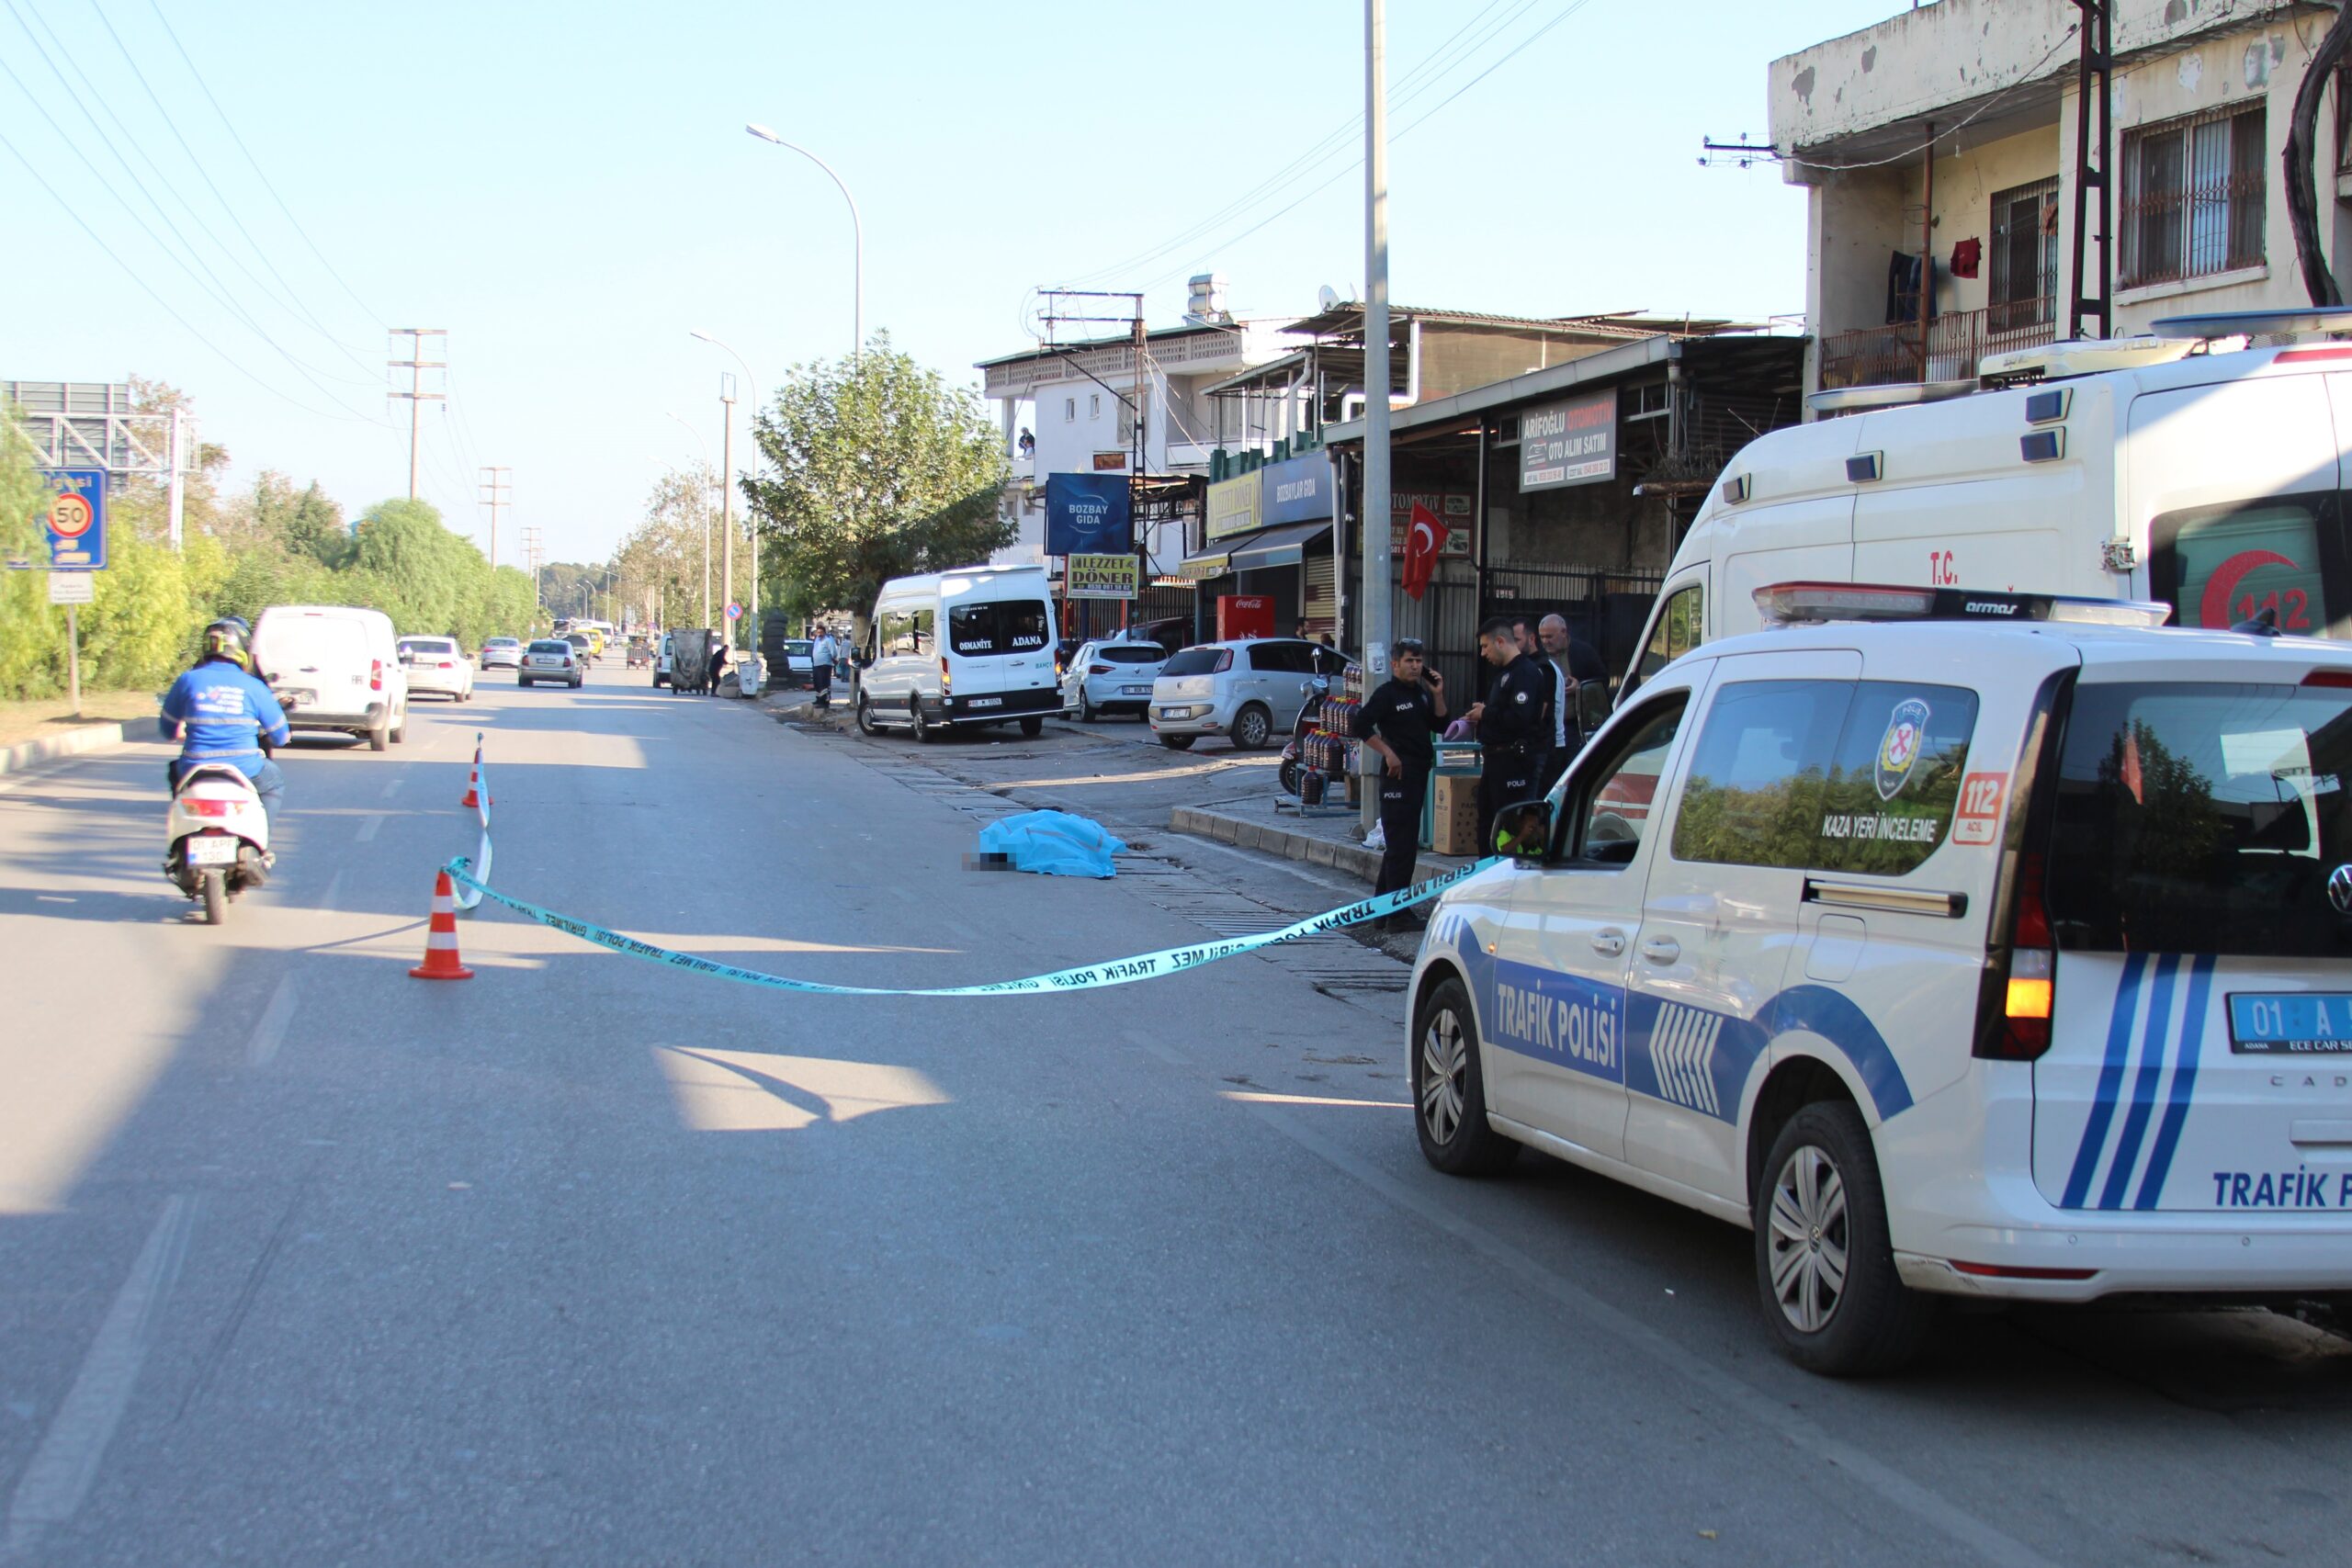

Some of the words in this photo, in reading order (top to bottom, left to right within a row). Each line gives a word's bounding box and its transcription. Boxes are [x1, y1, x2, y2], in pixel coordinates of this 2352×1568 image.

[1524, 410, 1566, 440] ARİFOĞLU
[1567, 398, 1613, 433] OTOMOTİV
[1548, 441, 1563, 461] OTO
[1564, 437, 1582, 458] ALIM
[1583, 432, 1607, 455] SATIM
[1276, 482, 1304, 503] BOZBAYLAR
[1303, 479, 1316, 499] GIDA
[57, 507, 85, 524] 50
[1069, 504, 1109, 514] BOZBAY
[1076, 514, 1101, 525] GIDA
[1083, 558, 1125, 570] LEZZET
[1930, 550, 1959, 585] T.C.
[1072, 569, 1134, 584] DÖNER
[1965, 602, 2018, 615] armas
[2236, 589, 2311, 629] 112
[959, 638, 992, 651] OSMANİYE
[1012, 636, 1043, 647] ADANA
[1396, 701, 1414, 713] POLİS
[1507, 779, 1526, 788] POLİS
[1966, 779, 1996, 814] 112
[1822, 815, 1850, 838] KAZA
[1852, 812, 1879, 840] YERİ
[1877, 811, 1938, 843] İNCELEME
[545, 913, 588, 937] GİRİLMEZ
[594, 930, 627, 948] POLİSİ
[628, 941, 665, 959] TRAFİK
[1498, 978, 1554, 1050] TRAFİK
[1557, 994, 1617, 1069] POLİSİ
[2252, 1000, 2284, 1037] 01
[2316, 999, 2333, 1036] A
[2290, 1041, 2312, 1051] ECE
[2314, 1041, 2339, 1051] CAR
[2213, 1164, 2329, 1207] TRAFİK
